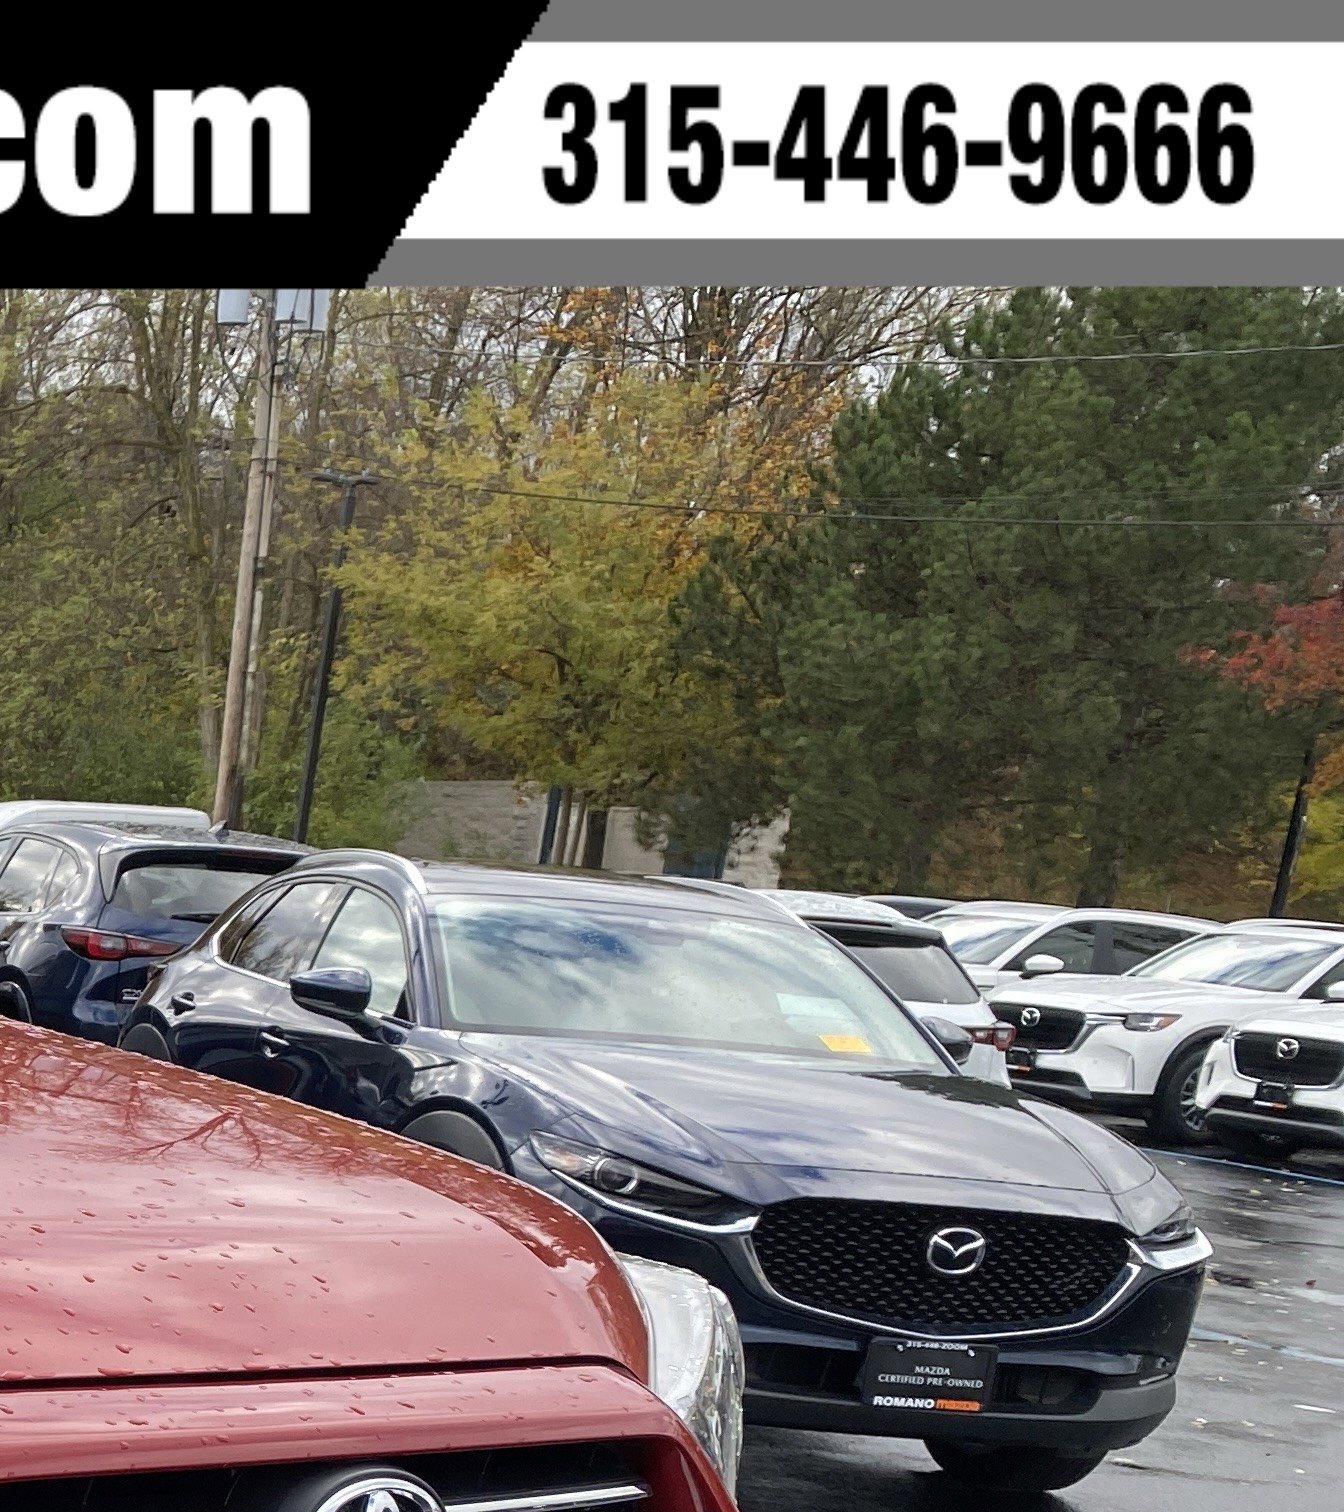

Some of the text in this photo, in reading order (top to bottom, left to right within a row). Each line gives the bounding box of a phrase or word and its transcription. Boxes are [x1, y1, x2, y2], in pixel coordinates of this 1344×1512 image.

[914, 1365, 951, 1376] MAZDA
[877, 1373, 984, 1389] CERTIFIED PRE-OWNED
[873, 1395, 935, 1410] ROMANO
